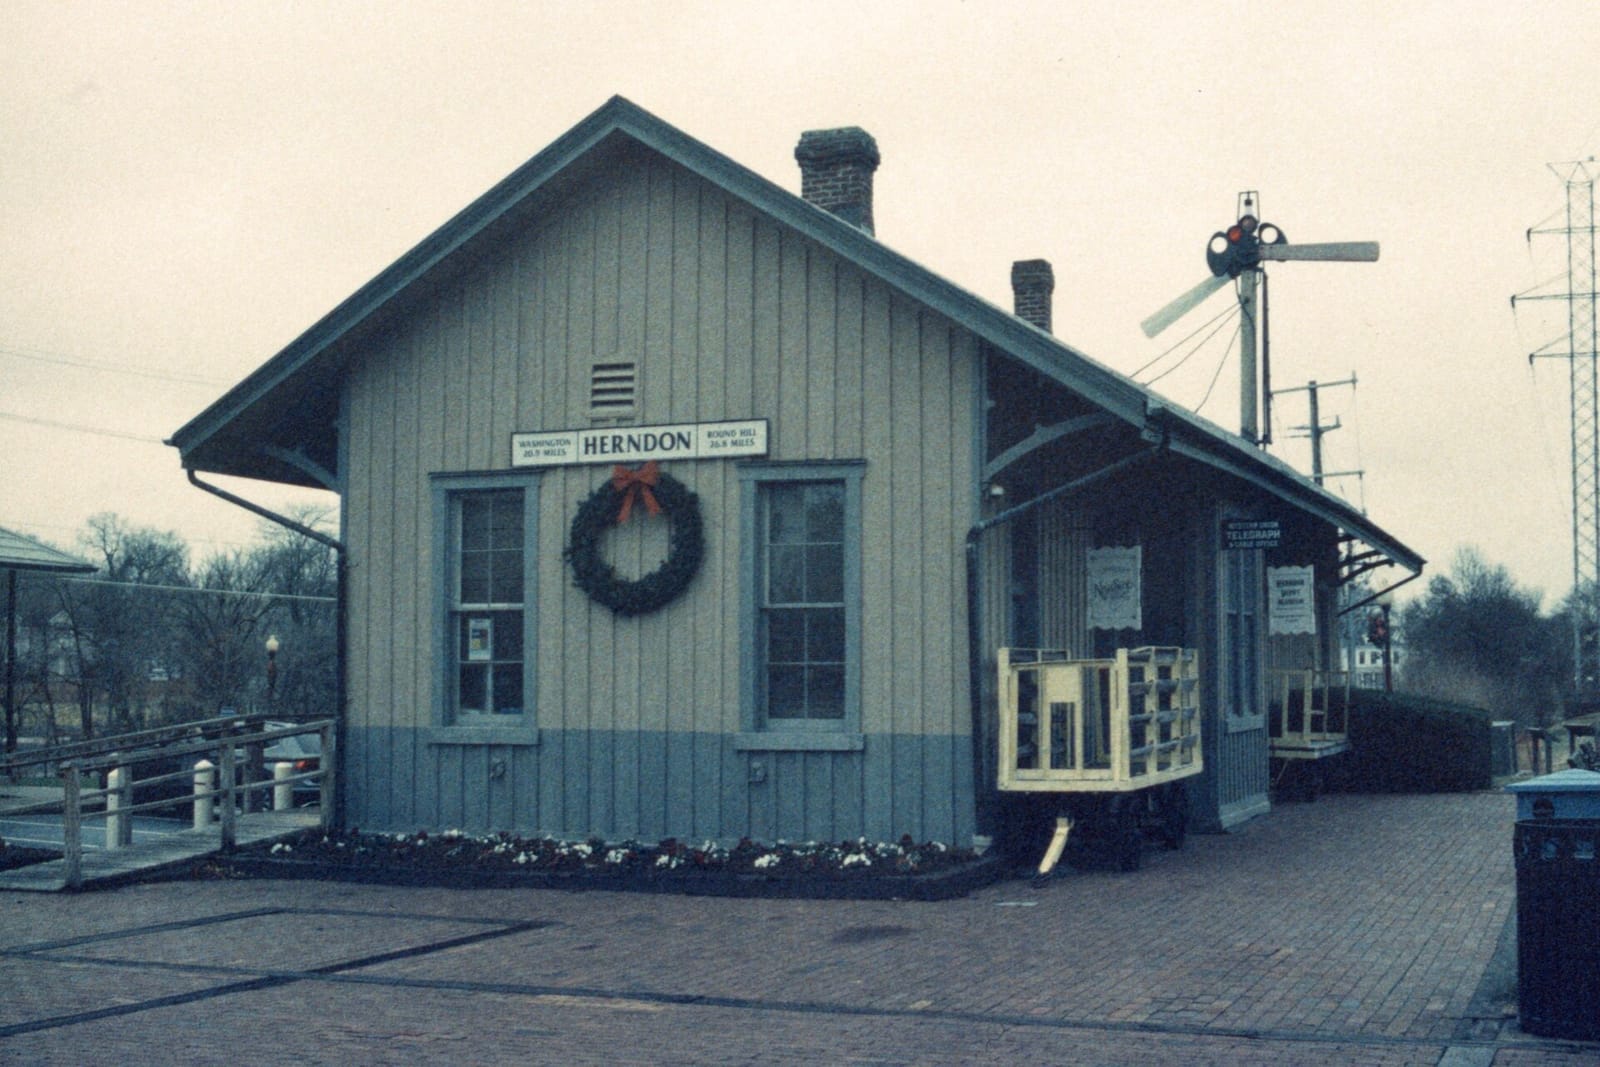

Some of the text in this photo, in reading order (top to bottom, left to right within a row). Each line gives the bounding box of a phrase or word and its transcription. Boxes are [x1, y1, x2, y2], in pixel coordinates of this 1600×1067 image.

[708, 428, 756, 438] ROUND HILL
[519, 438, 571, 448] WASHINGTON
[584, 432, 691, 454] HERNDON
[730, 438, 755, 446] MILES
[544, 448, 566, 457] MILES
[1226, 530, 1280, 540] TELEGRAPH
